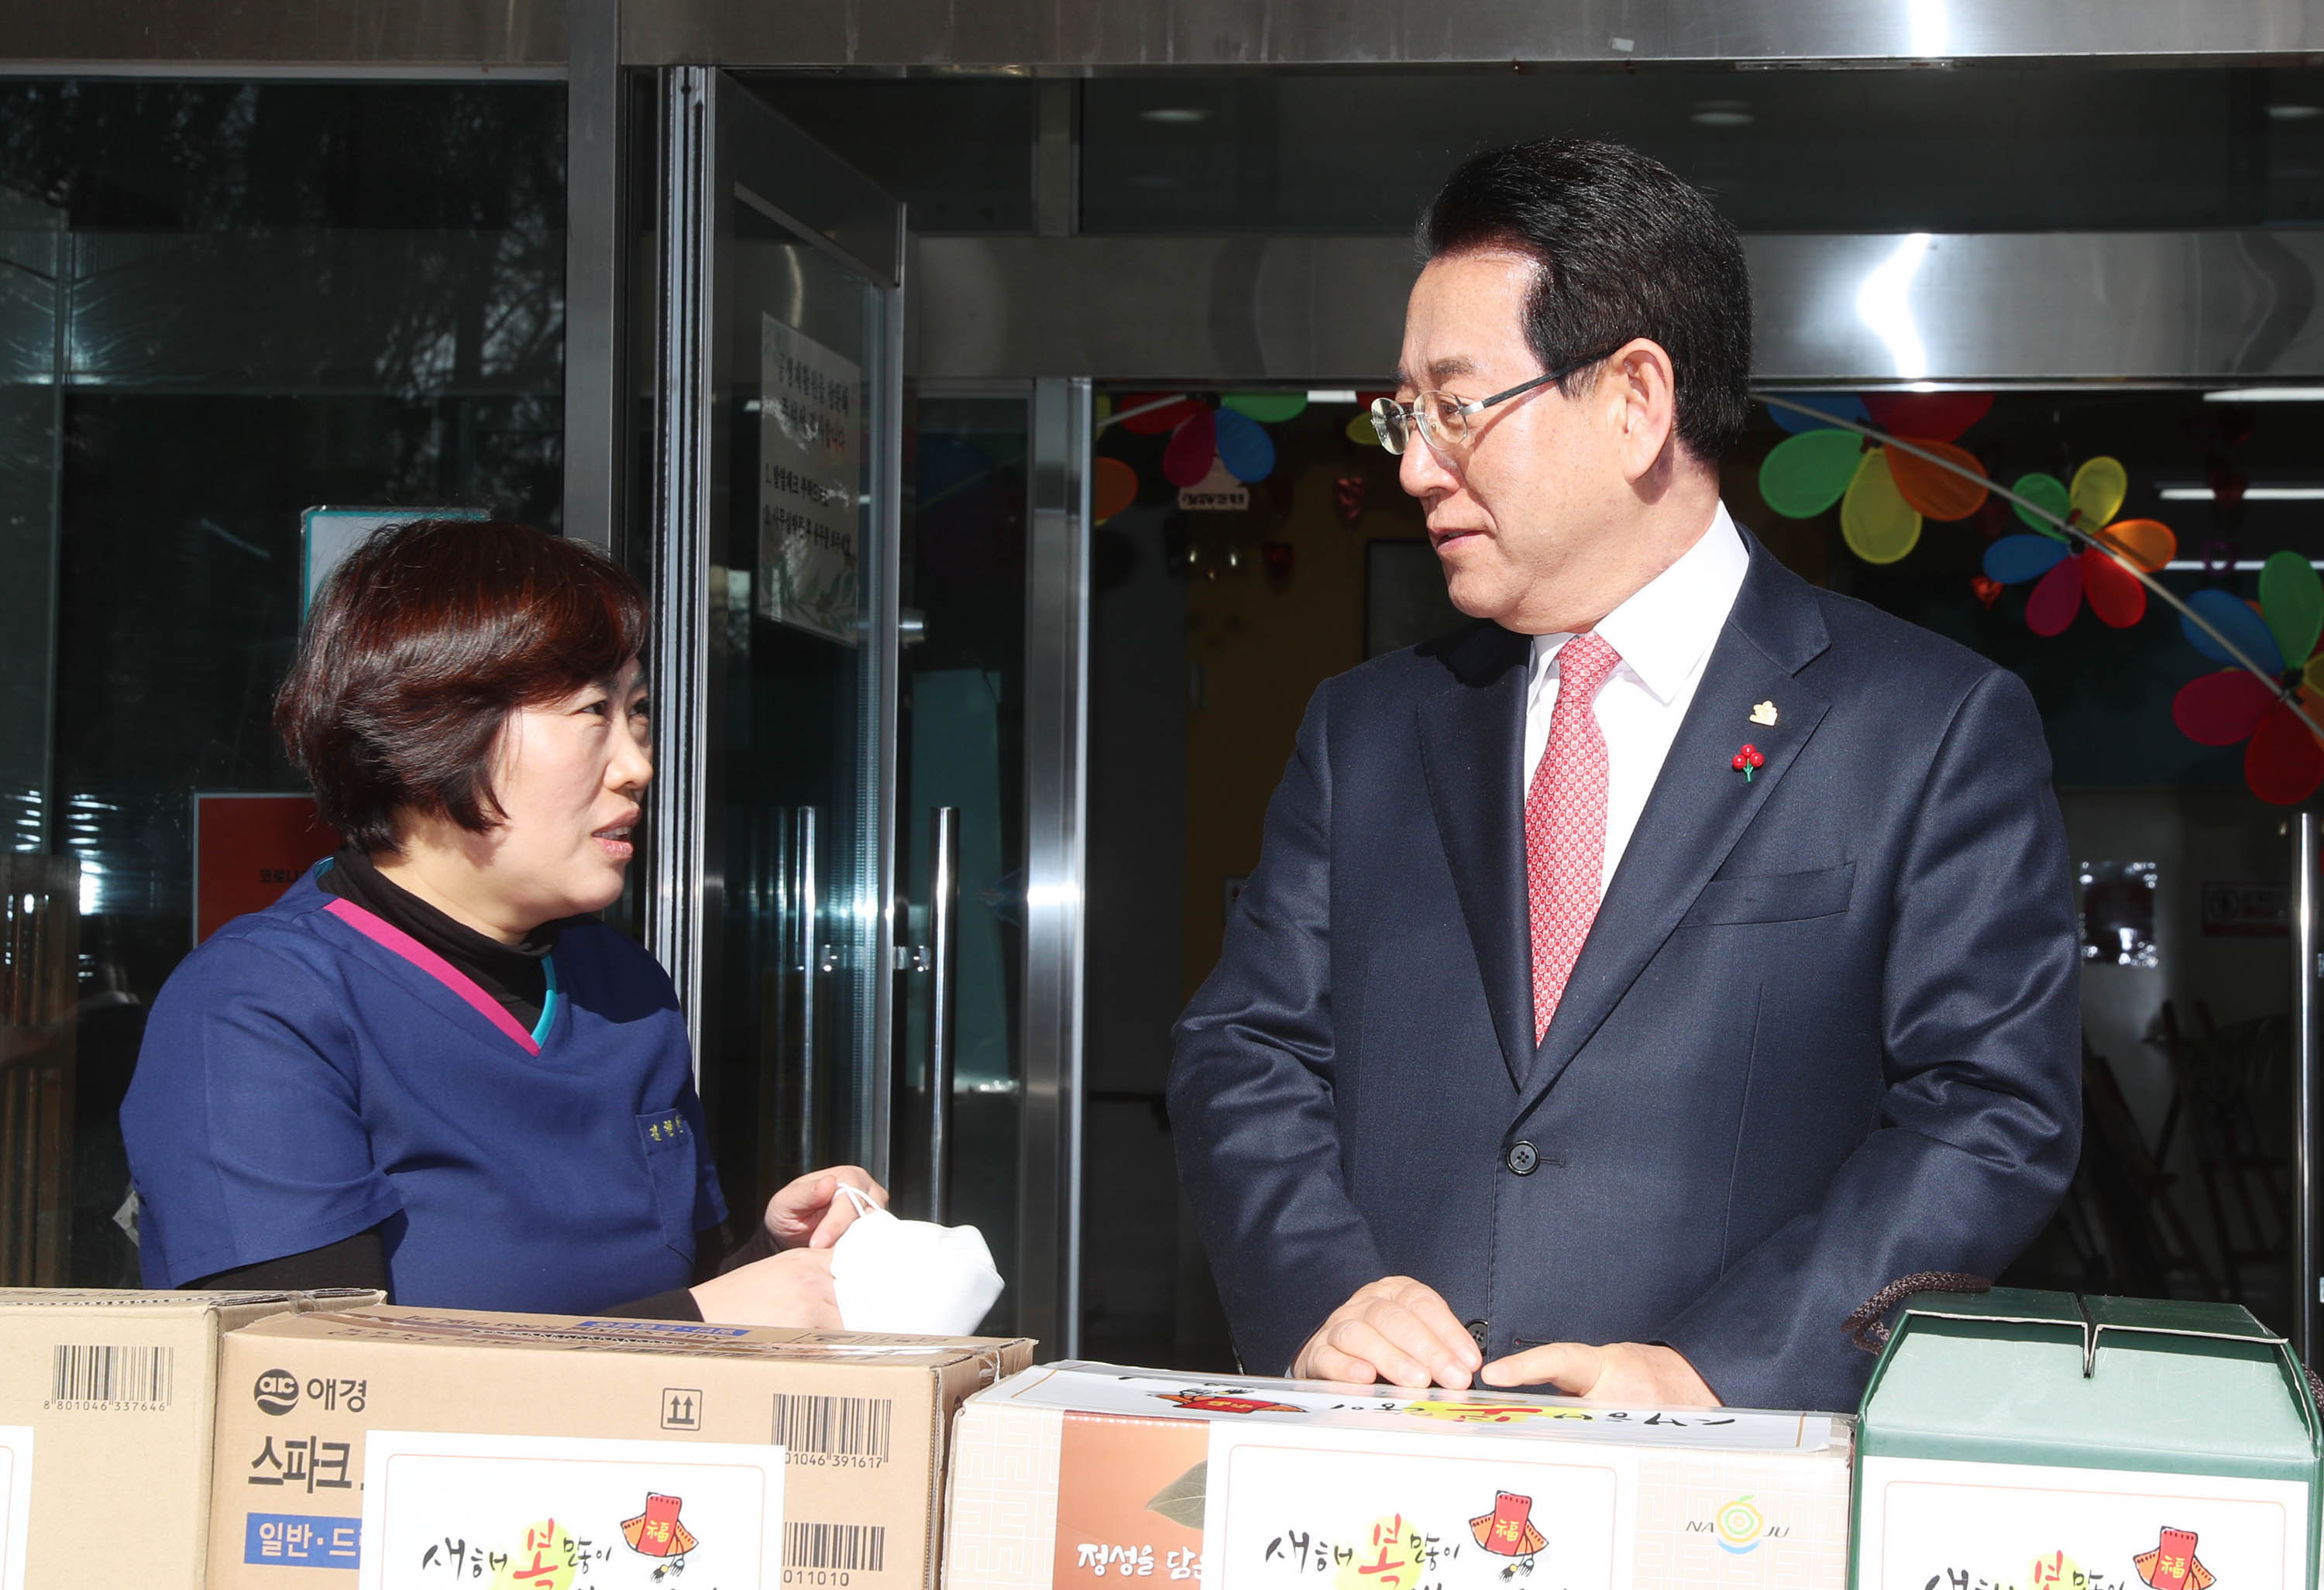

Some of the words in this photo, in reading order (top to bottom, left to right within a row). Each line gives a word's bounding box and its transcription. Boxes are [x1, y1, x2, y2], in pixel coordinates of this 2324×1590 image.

[307, 1378, 367, 1413] 애경
[248, 1435, 352, 1493] 스파크
[260, 1522, 361, 1557] 일반·드
[646, 1520, 670, 1543] 福
[1495, 1519, 1518, 1542] 福
[422, 1537, 508, 1581] 새해
[513, 1517, 559, 1590] 복
[562, 1536, 612, 1575] 많이
[1078, 1544, 1154, 1576] 정성을
[1266, 1530, 1353, 1574] 새해
[1358, 1513, 1405, 1590] 복
[1410, 1533, 1460, 1571] 많이
[2161, 1555, 2185, 1578] 福
[783, 1569, 850, 1587] 011010
